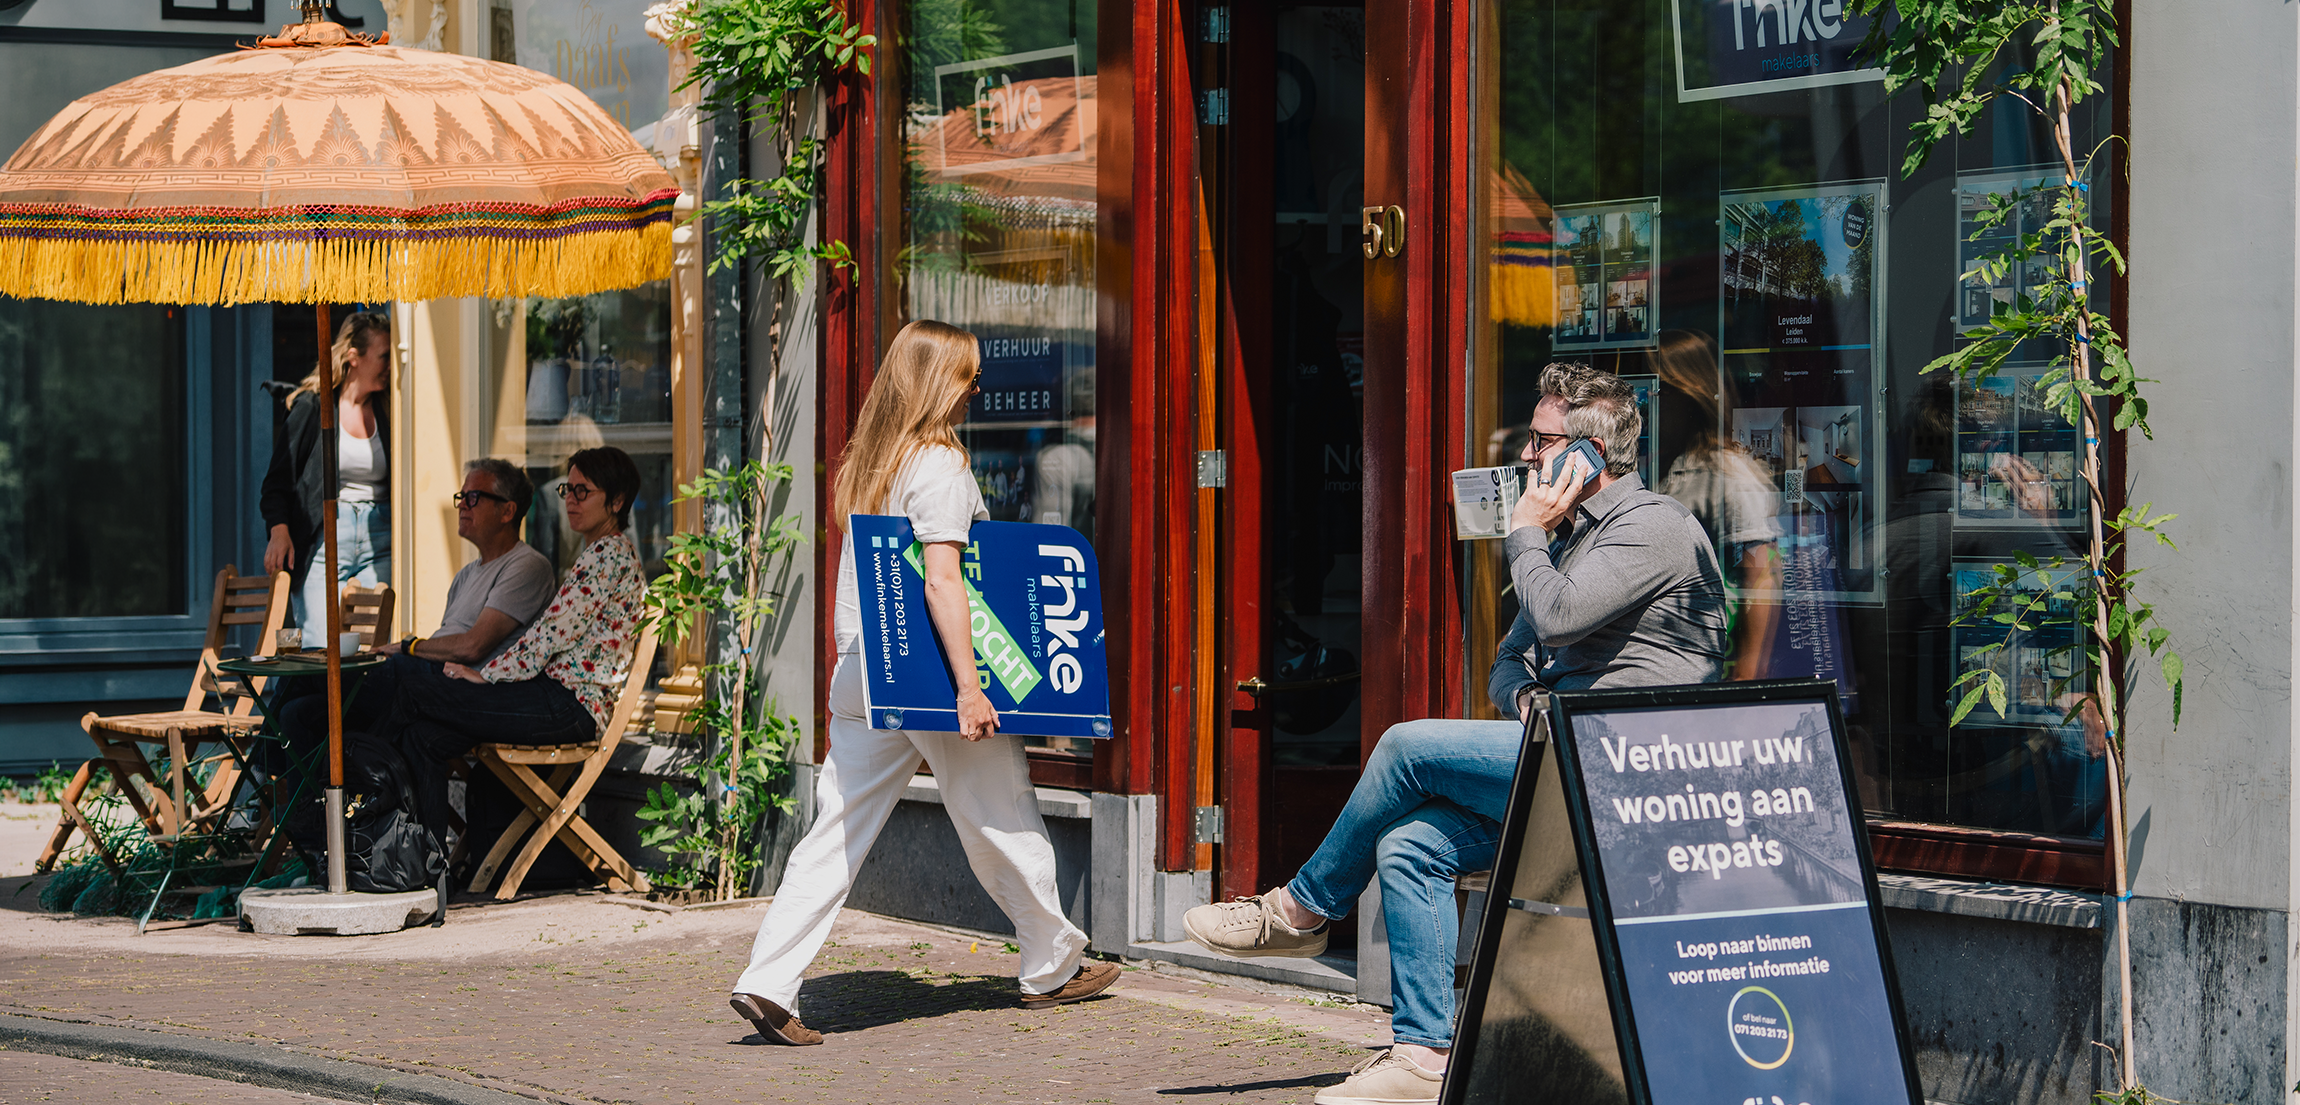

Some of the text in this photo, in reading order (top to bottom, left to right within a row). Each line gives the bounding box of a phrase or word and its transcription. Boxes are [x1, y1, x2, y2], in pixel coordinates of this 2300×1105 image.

[1761, 52, 1820, 73] makelaars
[974, 73, 1042, 138] finke
[1363, 205, 1405, 260] 50
[984, 283, 1050, 306] VERKOOP
[1777, 313, 1813, 326] Levendaal
[1785, 327, 1804, 336] Leiden
[984, 336, 1051, 359] VERHUUR
[984, 390, 1051, 411] BEHEER
[872, 551, 896, 684] www.finkemakelaars.nl
[889, 552, 909, 656] +31(0)71 203 21 73
[1026, 577, 1042, 658] makelaars
[1038, 544, 1090, 695] finke
[1599, 733, 1803, 773] Verhuur uw
[1612, 783, 1815, 827] woning aan
[1667, 833, 1784, 880] expats
[1676, 934, 1812, 961] Loop naar binnen
[1668, 955, 1830, 985] voor meer informatie
[1734, 1023, 1749, 1035] 071
[1749, 1025, 1766, 1037] 203
[1742, 1013, 1777, 1025] of bel naar
